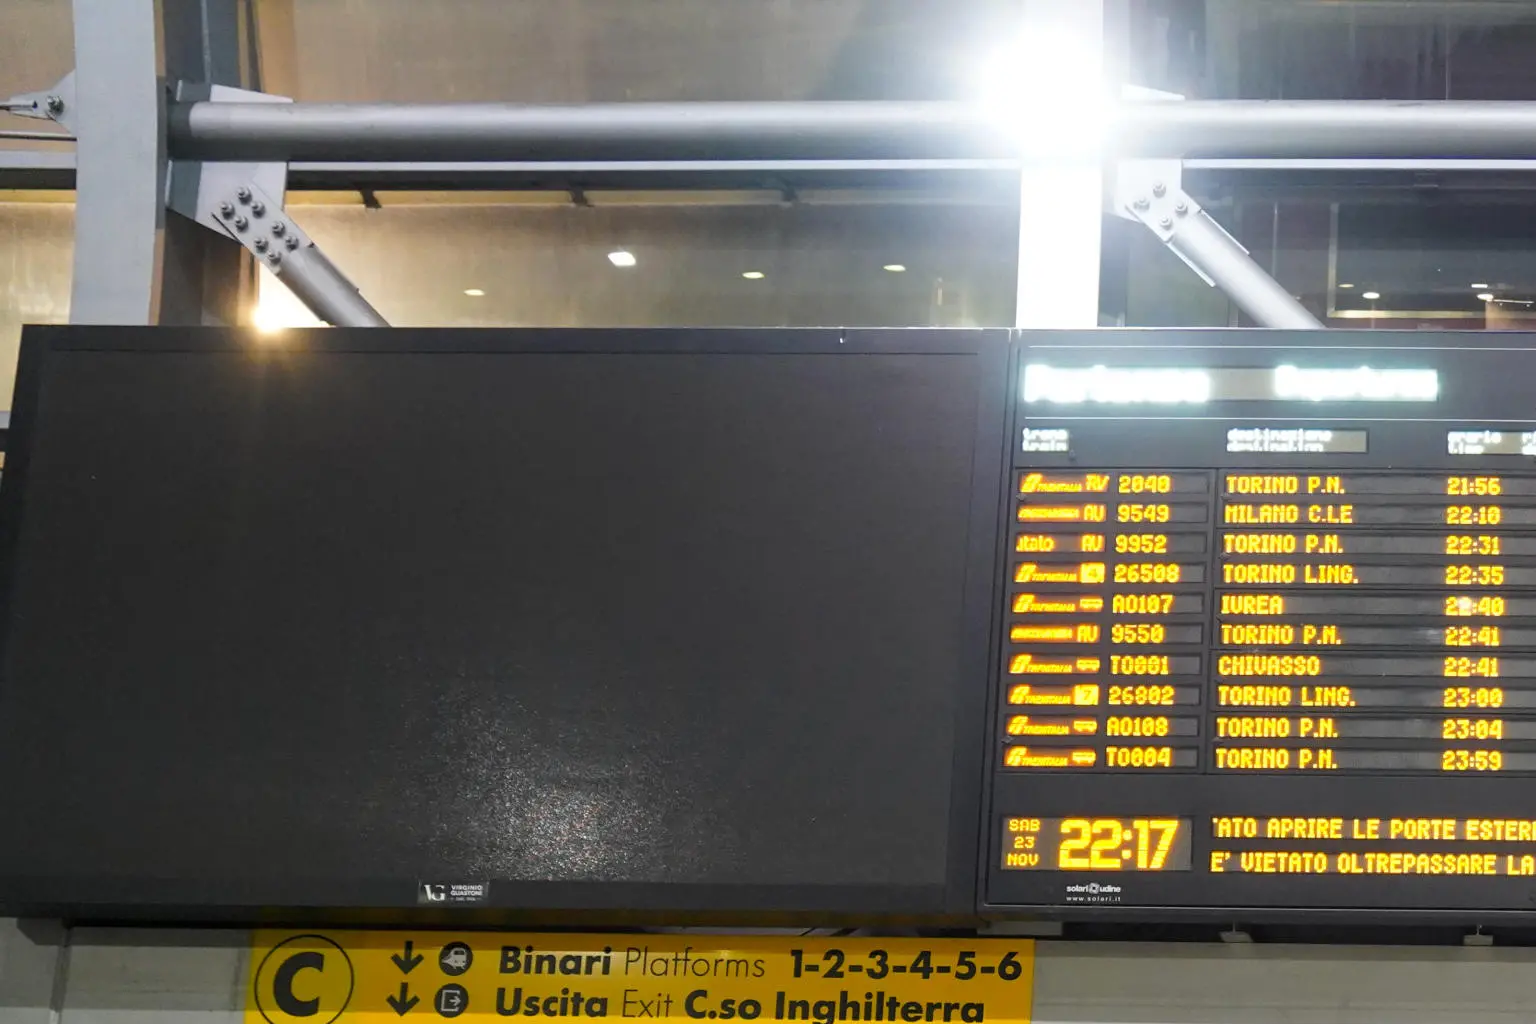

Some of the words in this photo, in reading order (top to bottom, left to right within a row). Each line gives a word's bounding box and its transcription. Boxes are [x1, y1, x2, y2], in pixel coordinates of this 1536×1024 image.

[1227, 476, 1298, 493] TORINO
[1308, 477, 1344, 493] P.N.
[1447, 478, 1500, 495] 21:56
[1118, 505, 1170, 522] 9549
[1225, 505, 1299, 523] MILANO
[1309, 505, 1352, 523] C.LE
[1447, 506, 1501, 524] 22:10
[1116, 535, 1166, 553] 9952
[1224, 535, 1296, 553] TORINO
[1306, 535, 1343, 553] P.N.
[1446, 536, 1500, 554] 22:31
[1115, 564, 1180, 582] 26508
[1224, 565, 1295, 583] TORINO
[1305, 565, 1357, 583] LING.
[1446, 566, 1504, 584] 22:35
[1113, 595, 1173, 613] AO107
[1112, 624, 1164, 643] 9550
[1222, 625, 1294, 644] TORINO
[1304, 625, 1341, 644] P.N.
[1445, 627, 1500, 646] 22:41
[1111, 656, 1168, 674] TO001
[1444, 657, 1498, 676] 22:41
[1109, 686, 1175, 704] 26802
[1219, 686, 1292, 705] TORINO
[1302, 687, 1355, 706] LING.
[1444, 688, 1504, 707] 23:00
[1107, 717, 1168, 736] AO108
[1217, 718, 1290, 737] TORINO
[1300, 718, 1337, 737] P.N.
[1443, 719, 1503, 739] 23:04
[1107, 747, 1171, 766] TO004
[1216, 749, 1289, 768] TORINO
[1299, 749, 1336, 768] P.N.
[1443, 751, 1502, 770] 23:59
[1009, 819, 1040, 832] SAB
[1267, 818, 1342, 838] APRIRE
[1353, 819, 1380, 839] LE
[1390, 819, 1456, 839] PORTE
[1014, 836, 1035, 849] 23
[1058, 819, 1179, 869] 22:17
[1007, 853, 1039, 866] NOV
[1337, 853, 1497, 874] OLTREPASSARE
[1507, 856, 1535, 875] LA
[1066, 884, 1089, 893] solari
[1099, 884, 1121, 893] udine
[500, 946, 611, 976] Binari
[625, 947, 766, 979] Platforms
[791, 950, 1022, 981] 1-2-3-4-5-6
[273, 952, 324, 1017] C
[495, 988, 608, 1018] Uscita
[622, 989, 673, 1020] Exit
[684, 990, 761, 1021] C.so
